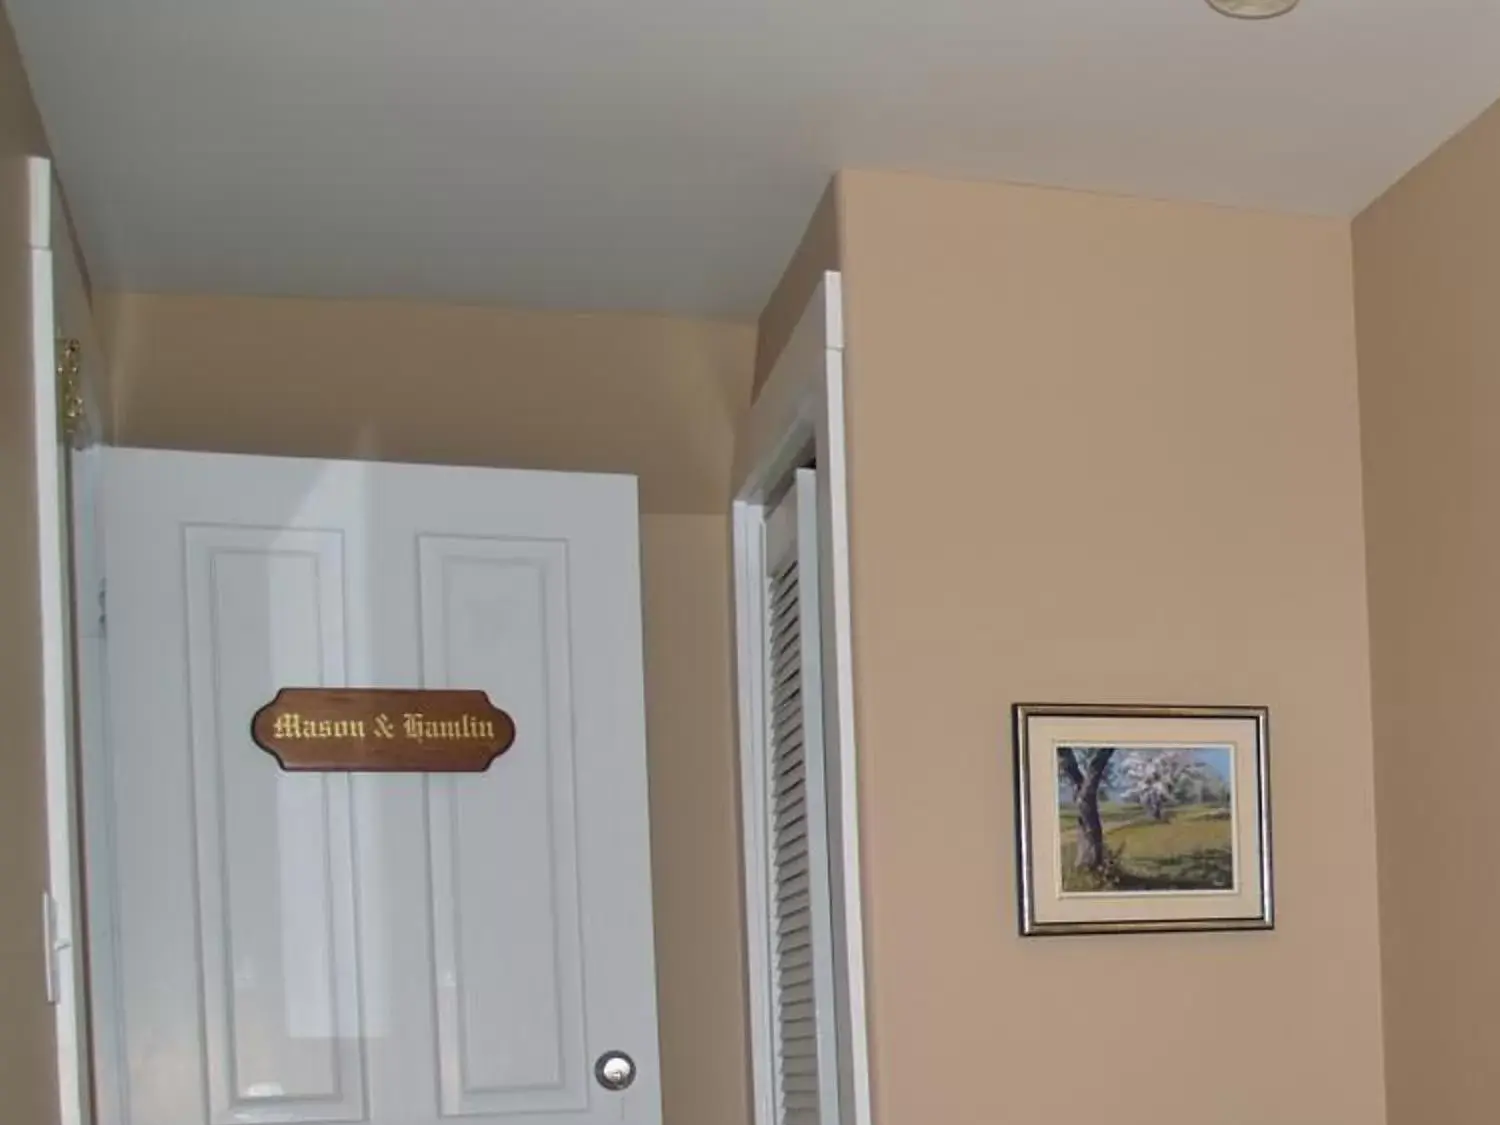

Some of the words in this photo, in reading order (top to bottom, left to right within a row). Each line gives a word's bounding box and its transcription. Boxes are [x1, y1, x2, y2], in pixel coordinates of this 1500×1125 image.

[273, 713, 365, 738] Mason
[372, 713, 395, 739] &
[403, 712, 495, 744] Hamlin
